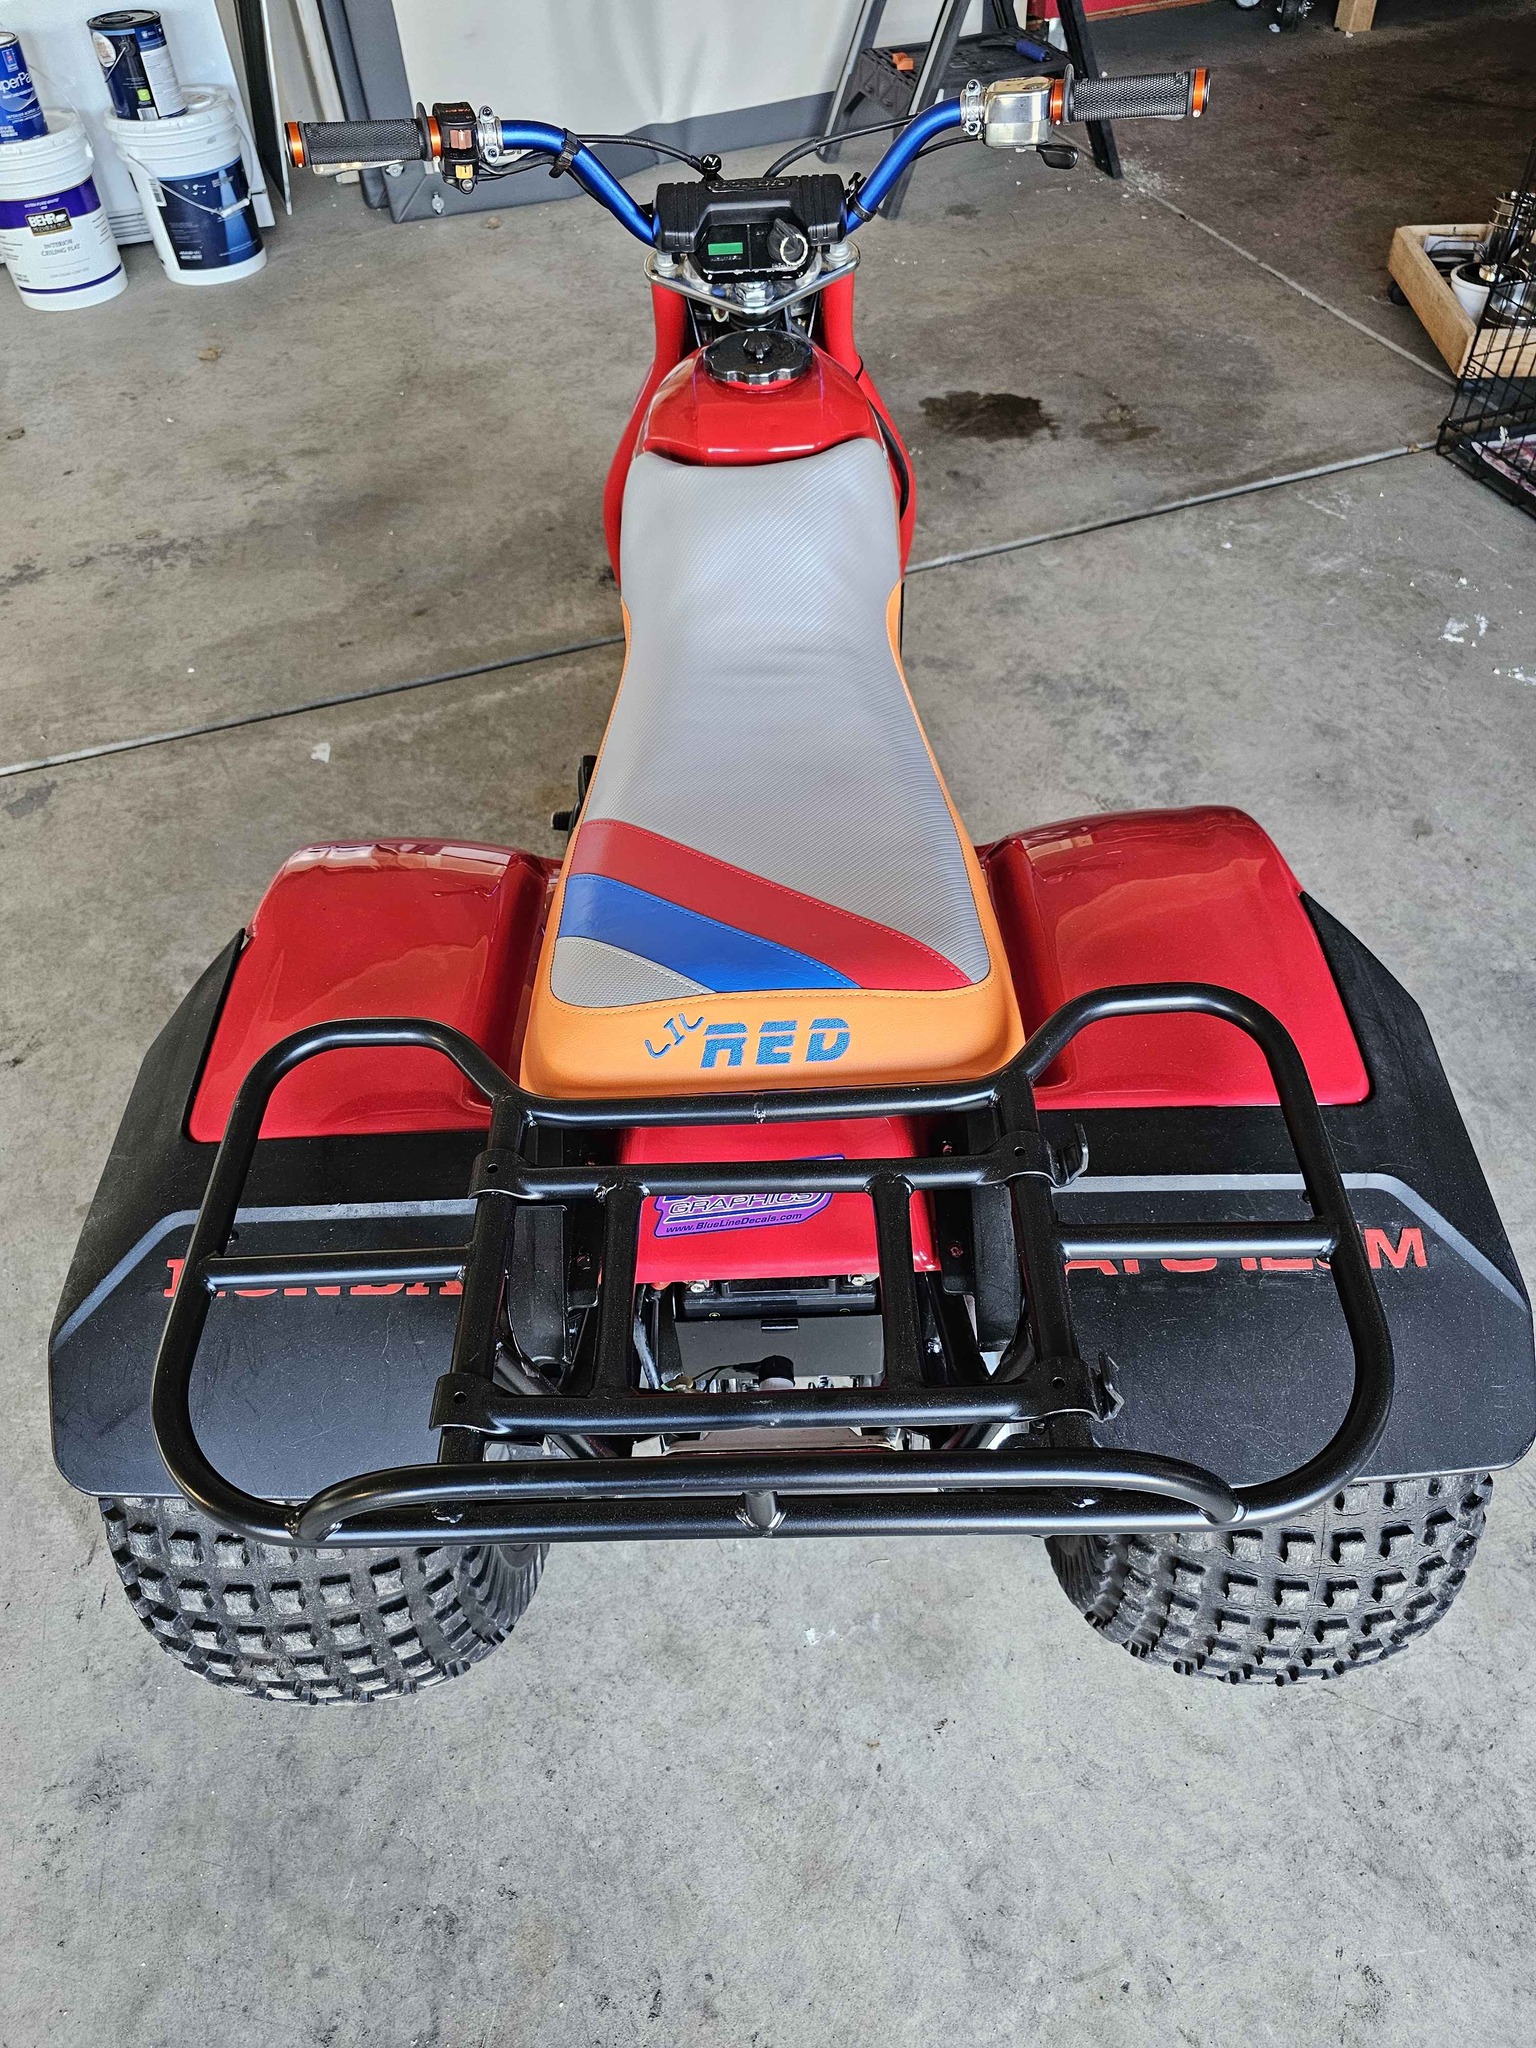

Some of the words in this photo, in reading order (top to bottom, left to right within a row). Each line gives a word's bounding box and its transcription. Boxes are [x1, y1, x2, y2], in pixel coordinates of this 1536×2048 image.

[27, 213, 56, 227] BEHR
[644, 1012, 704, 1059] LIL
[700, 1017, 851, 1069] RED
[669, 1193, 812, 1215] GRAPHICS
[666, 1212, 802, 1233] www.BlueLineDecals.com
